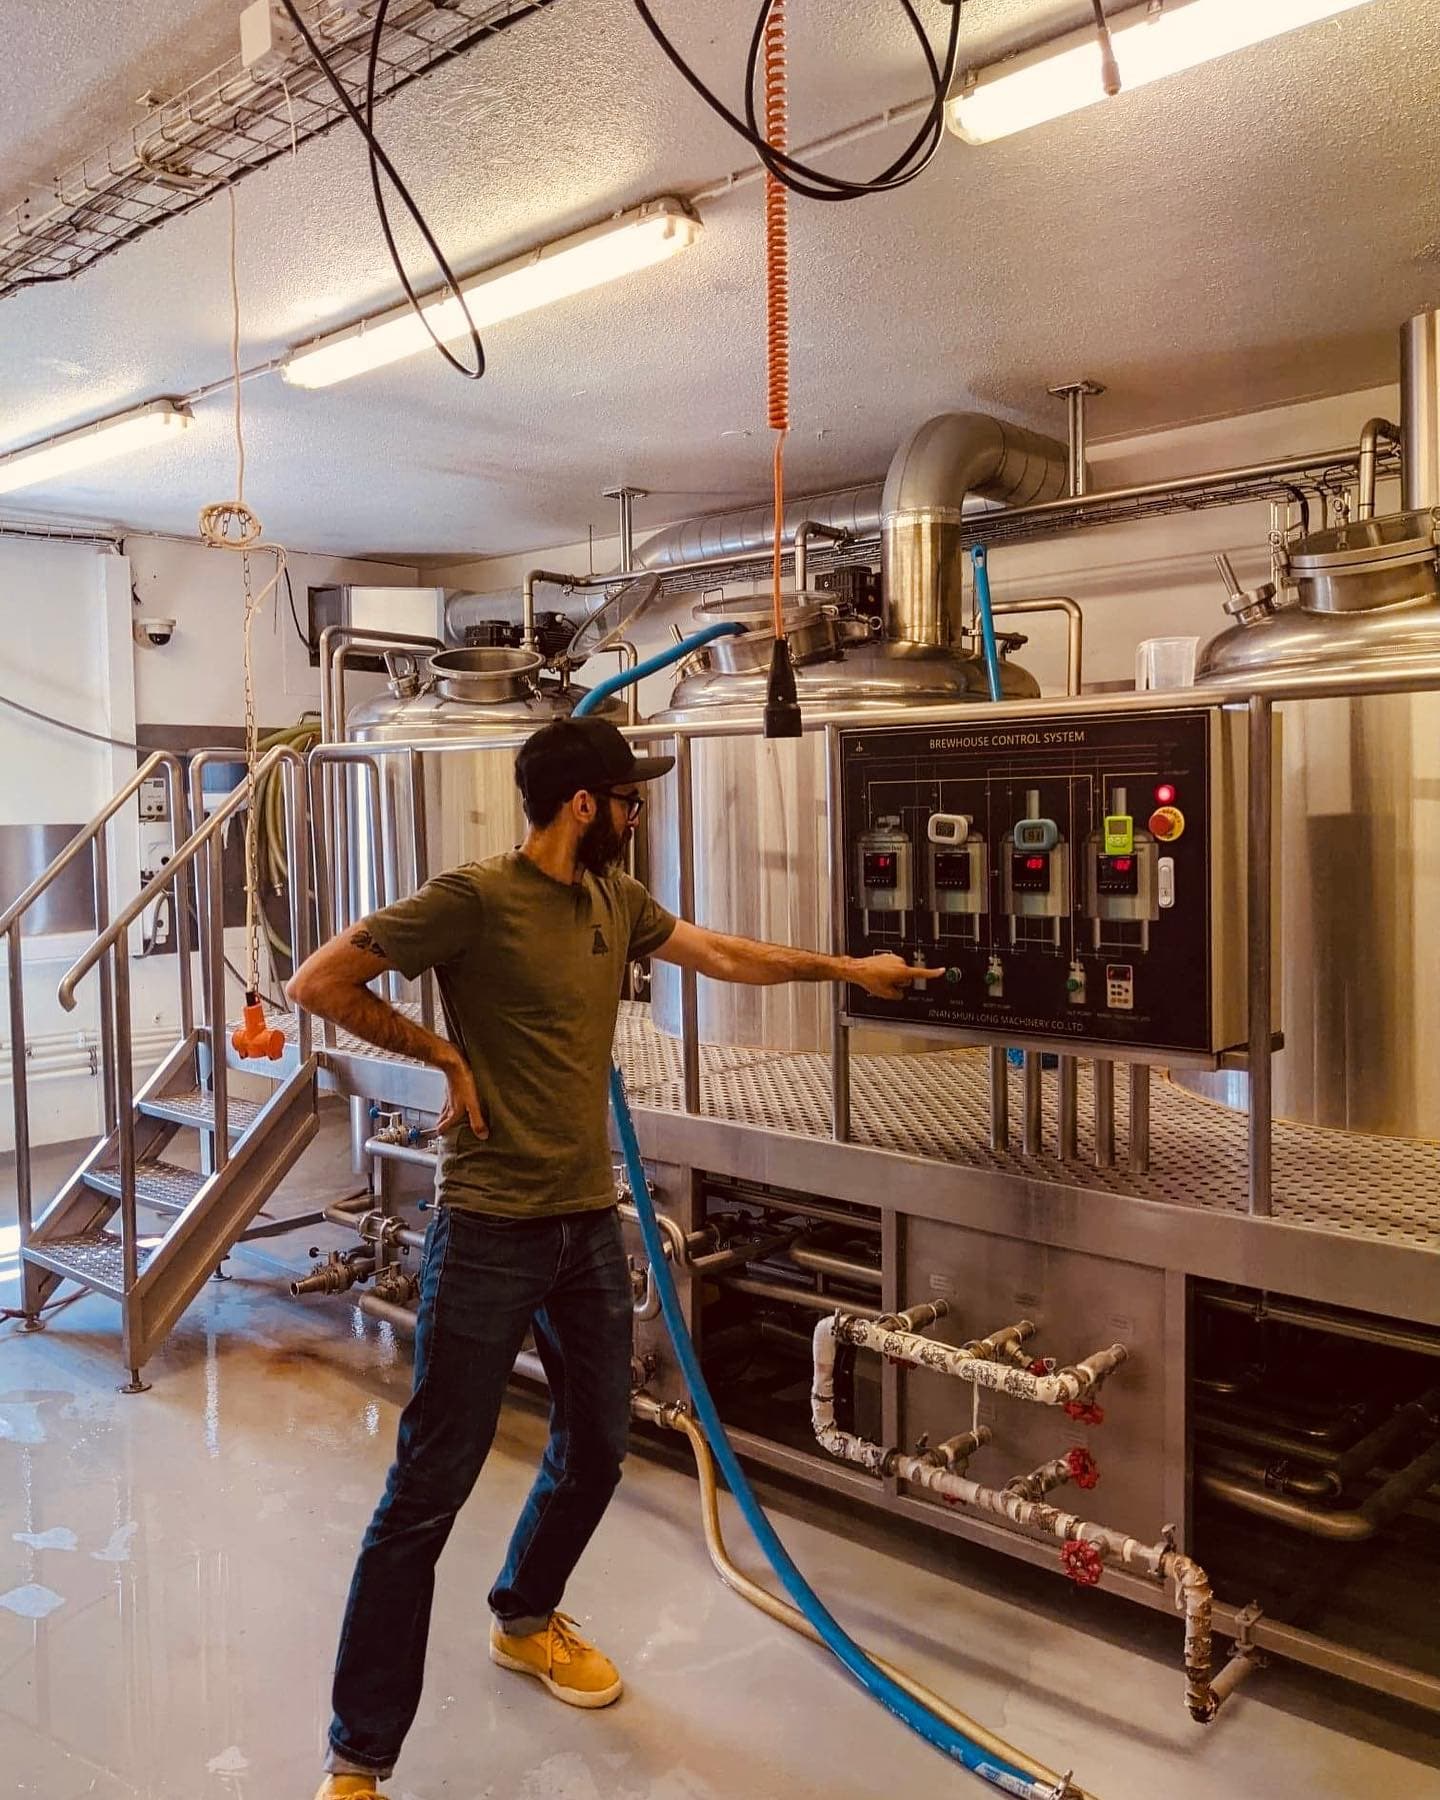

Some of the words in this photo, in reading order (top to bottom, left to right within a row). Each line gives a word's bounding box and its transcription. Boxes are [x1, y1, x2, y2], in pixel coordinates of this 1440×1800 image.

[929, 736, 989, 749] BREWHOUSE
[991, 733, 1041, 746] CONTROL
[1043, 731, 1085, 743] SYSTEM
[952, 1010, 975, 1021] SHUN
[976, 1013, 999, 1024] LONG
[1000, 1016, 1049, 1028] MACHINERY
